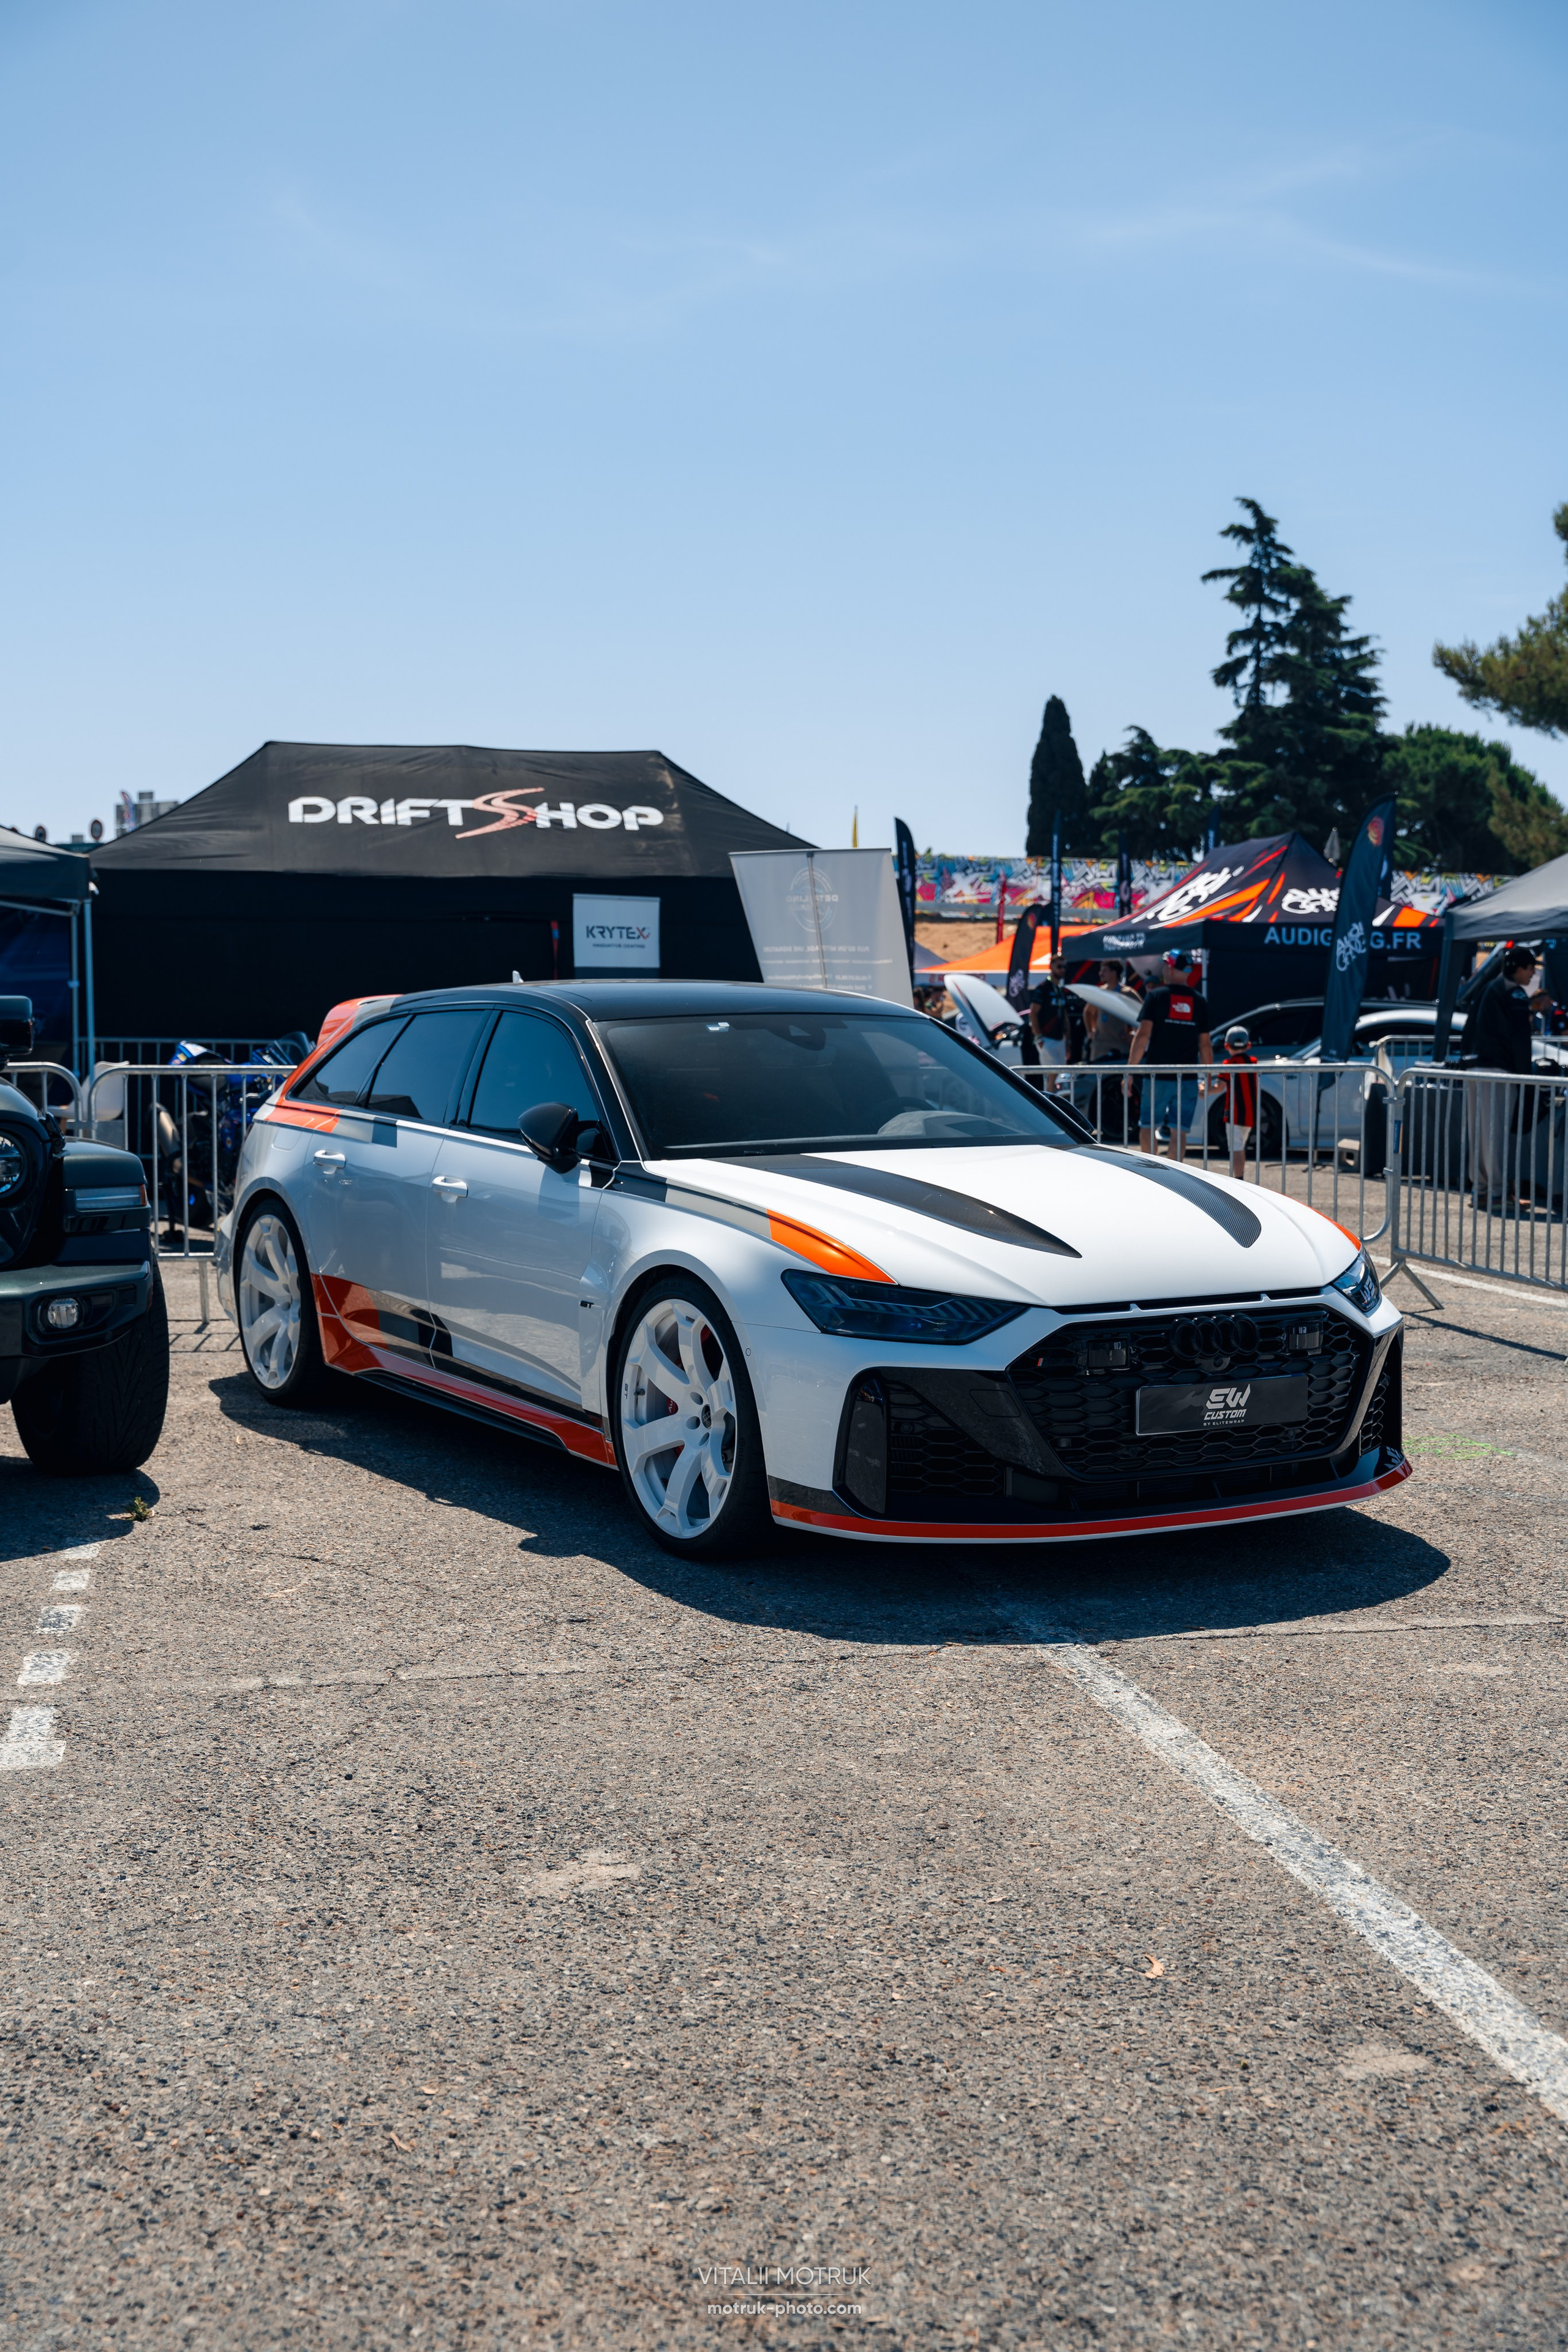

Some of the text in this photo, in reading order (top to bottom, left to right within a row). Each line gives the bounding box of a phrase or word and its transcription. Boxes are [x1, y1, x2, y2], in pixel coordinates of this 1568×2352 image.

[586, 925, 650, 940] KRYTEX
[1264, 925, 1422, 949] AUDIGG.FR
[580, 1300, 594, 1309] GT
[1204, 1409, 1247, 1420] CUSTOM
